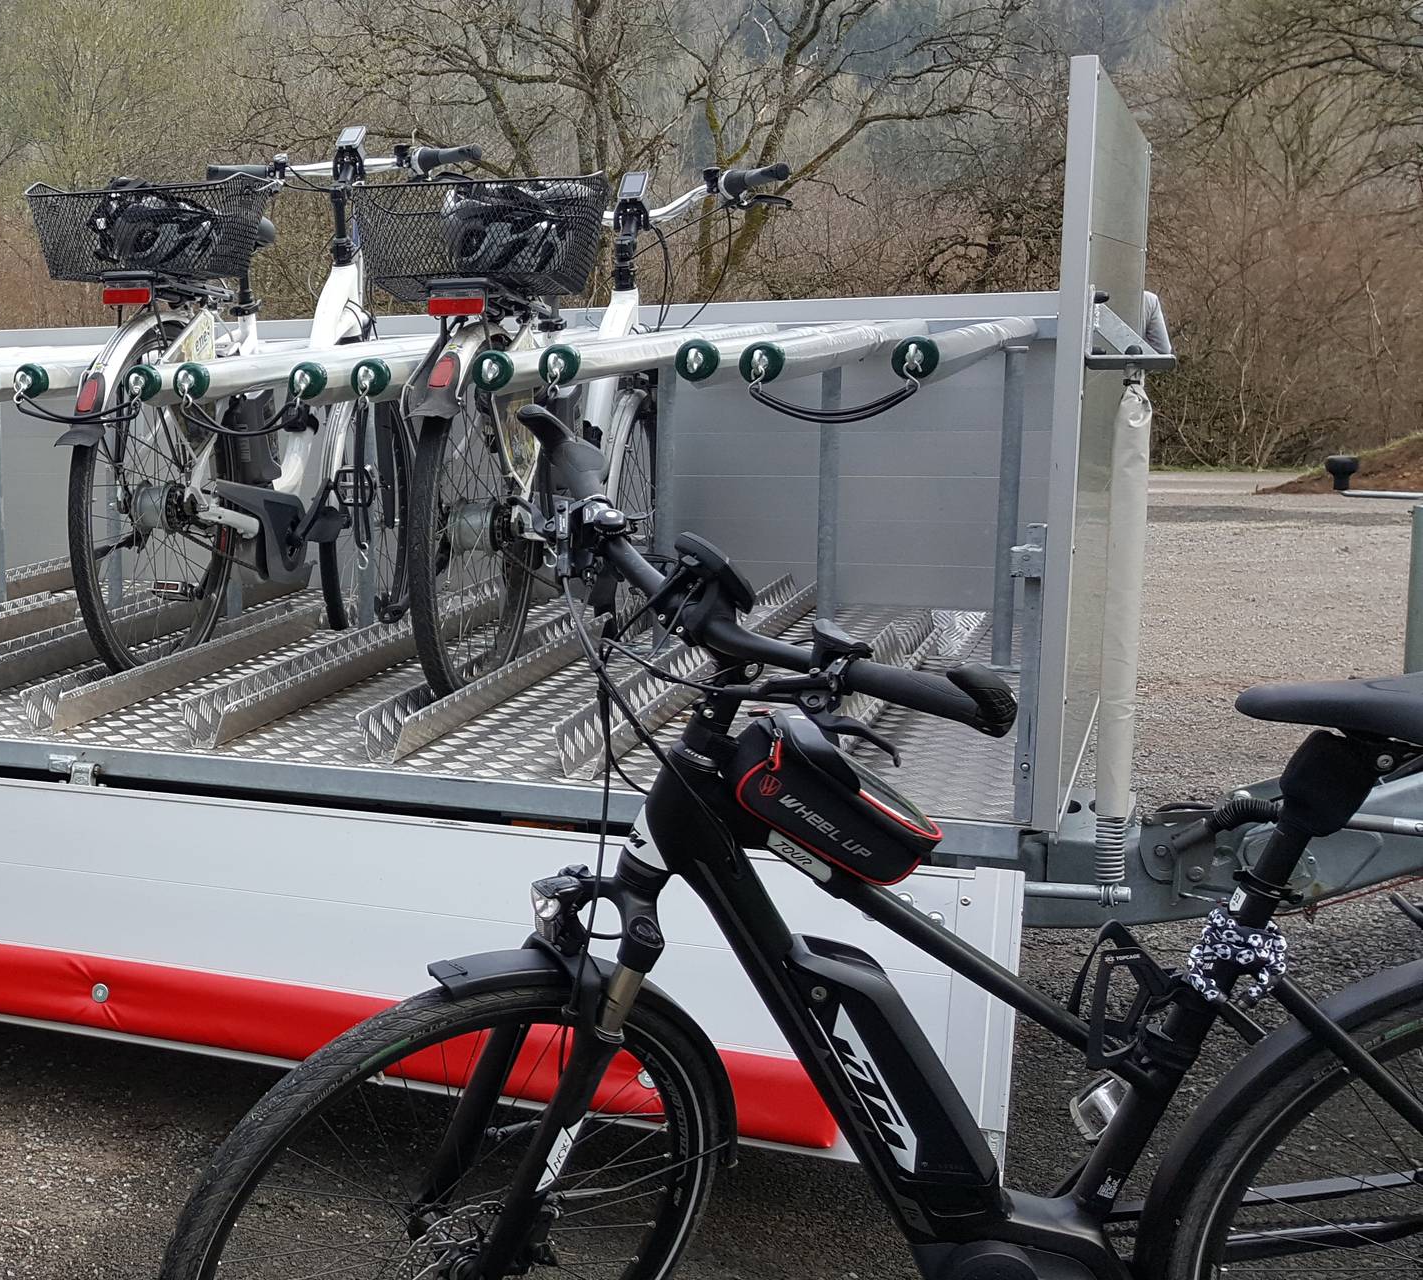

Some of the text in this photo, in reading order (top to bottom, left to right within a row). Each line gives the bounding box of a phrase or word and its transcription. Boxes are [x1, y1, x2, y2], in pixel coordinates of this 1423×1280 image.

[778, 794, 873, 858] WHEEL UP
[773, 840, 813, 866] TOUR
